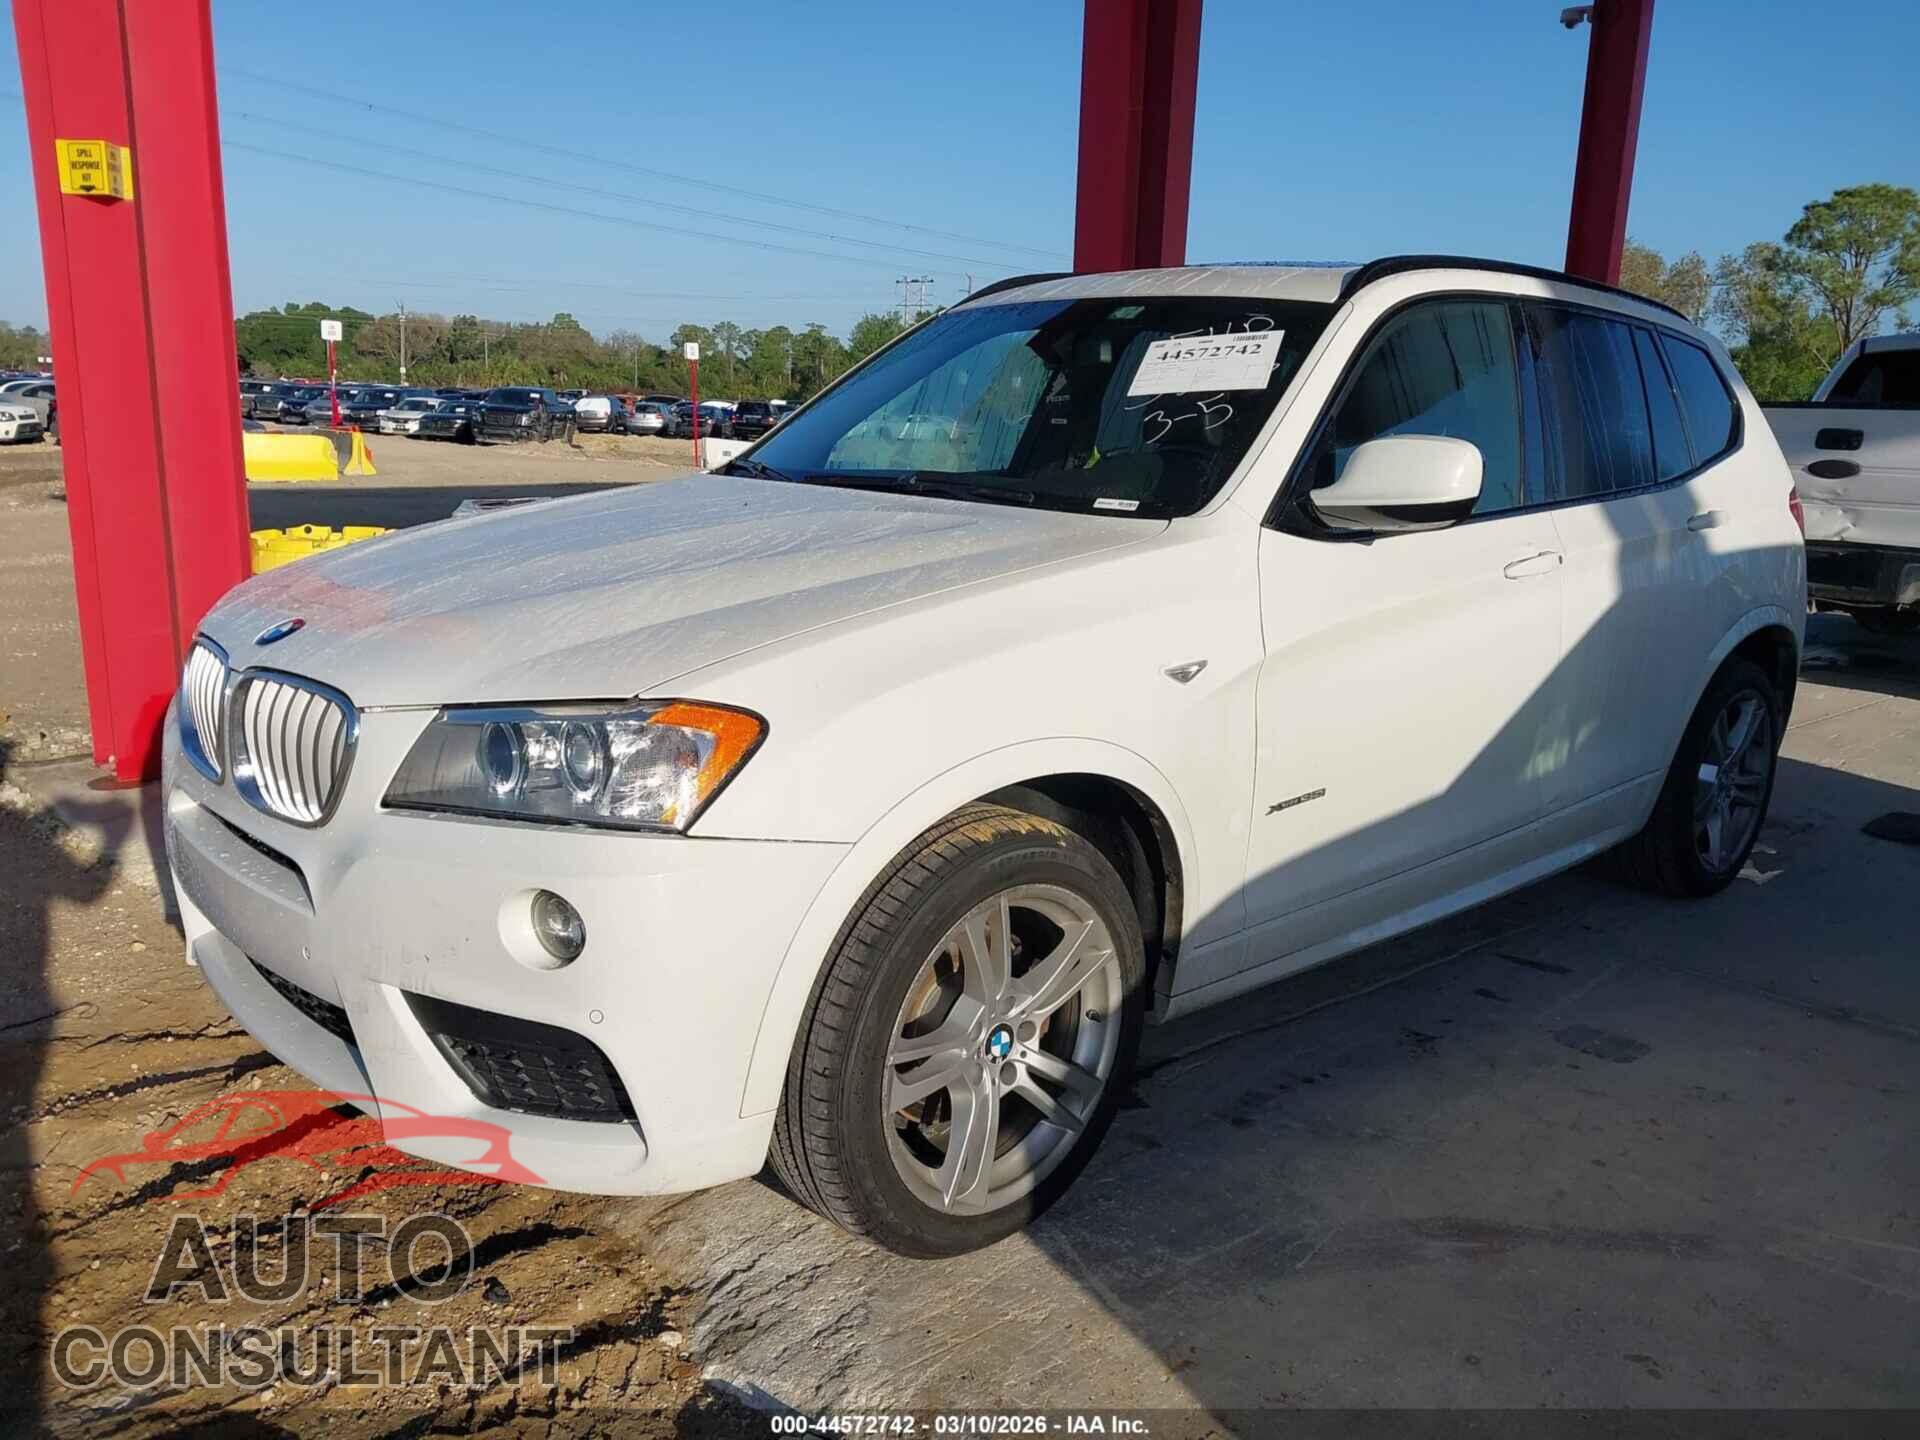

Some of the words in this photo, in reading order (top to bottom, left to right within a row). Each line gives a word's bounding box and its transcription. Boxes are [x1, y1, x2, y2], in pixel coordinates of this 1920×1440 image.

[76, 148, 93, 158] SPILL
[71, 160, 101, 170] RESPONSE
[81, 173, 92, 182] KIT
[1156, 343, 1263, 362] 44572742
